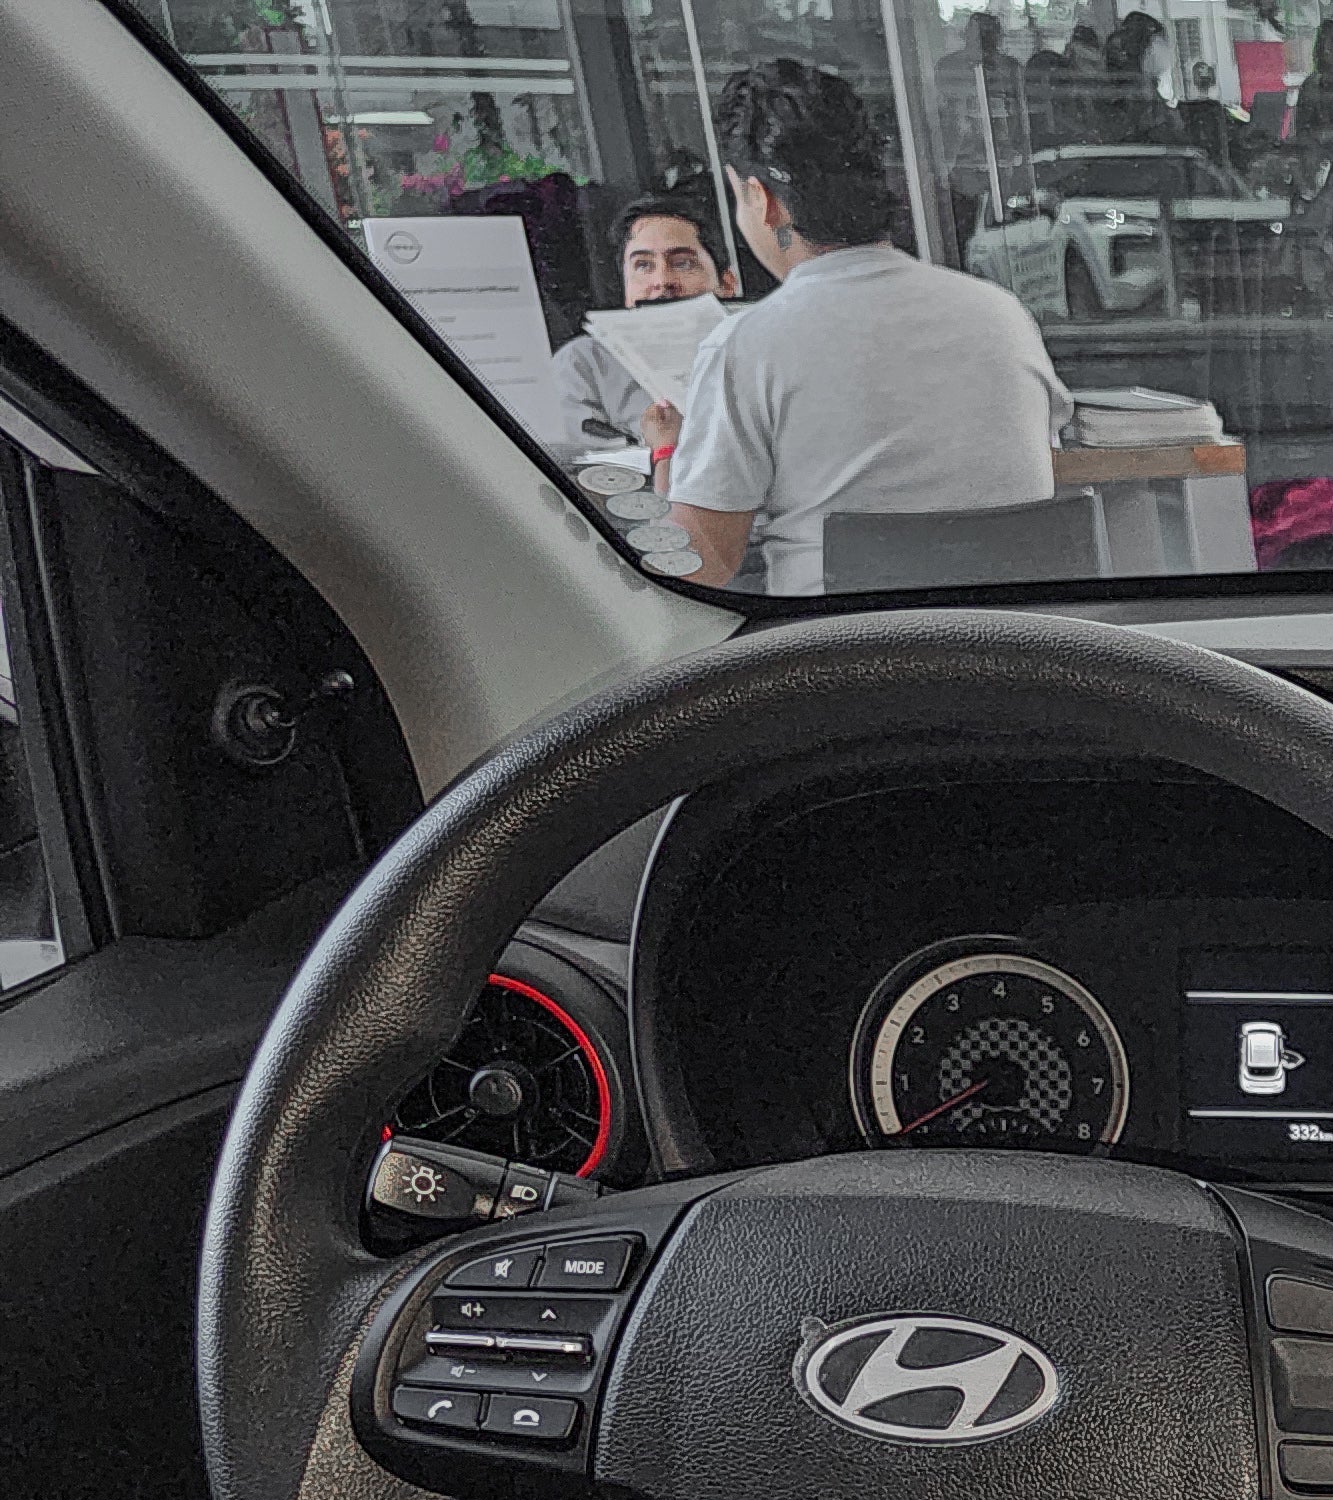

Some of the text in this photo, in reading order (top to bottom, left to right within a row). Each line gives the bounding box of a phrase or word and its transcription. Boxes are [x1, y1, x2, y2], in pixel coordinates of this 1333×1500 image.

[993, 981, 1006, 997] 4
[947, 994, 959, 1011] 3
[1042, 996, 1054, 1014] 5
[913, 1027, 925, 1044] 2
[1077, 1030, 1090, 1047] 6
[1091, 1076, 1105, 1094] 7
[1077, 1122, 1091, 1140] 8
[563, 1258, 605, 1275] MODE
